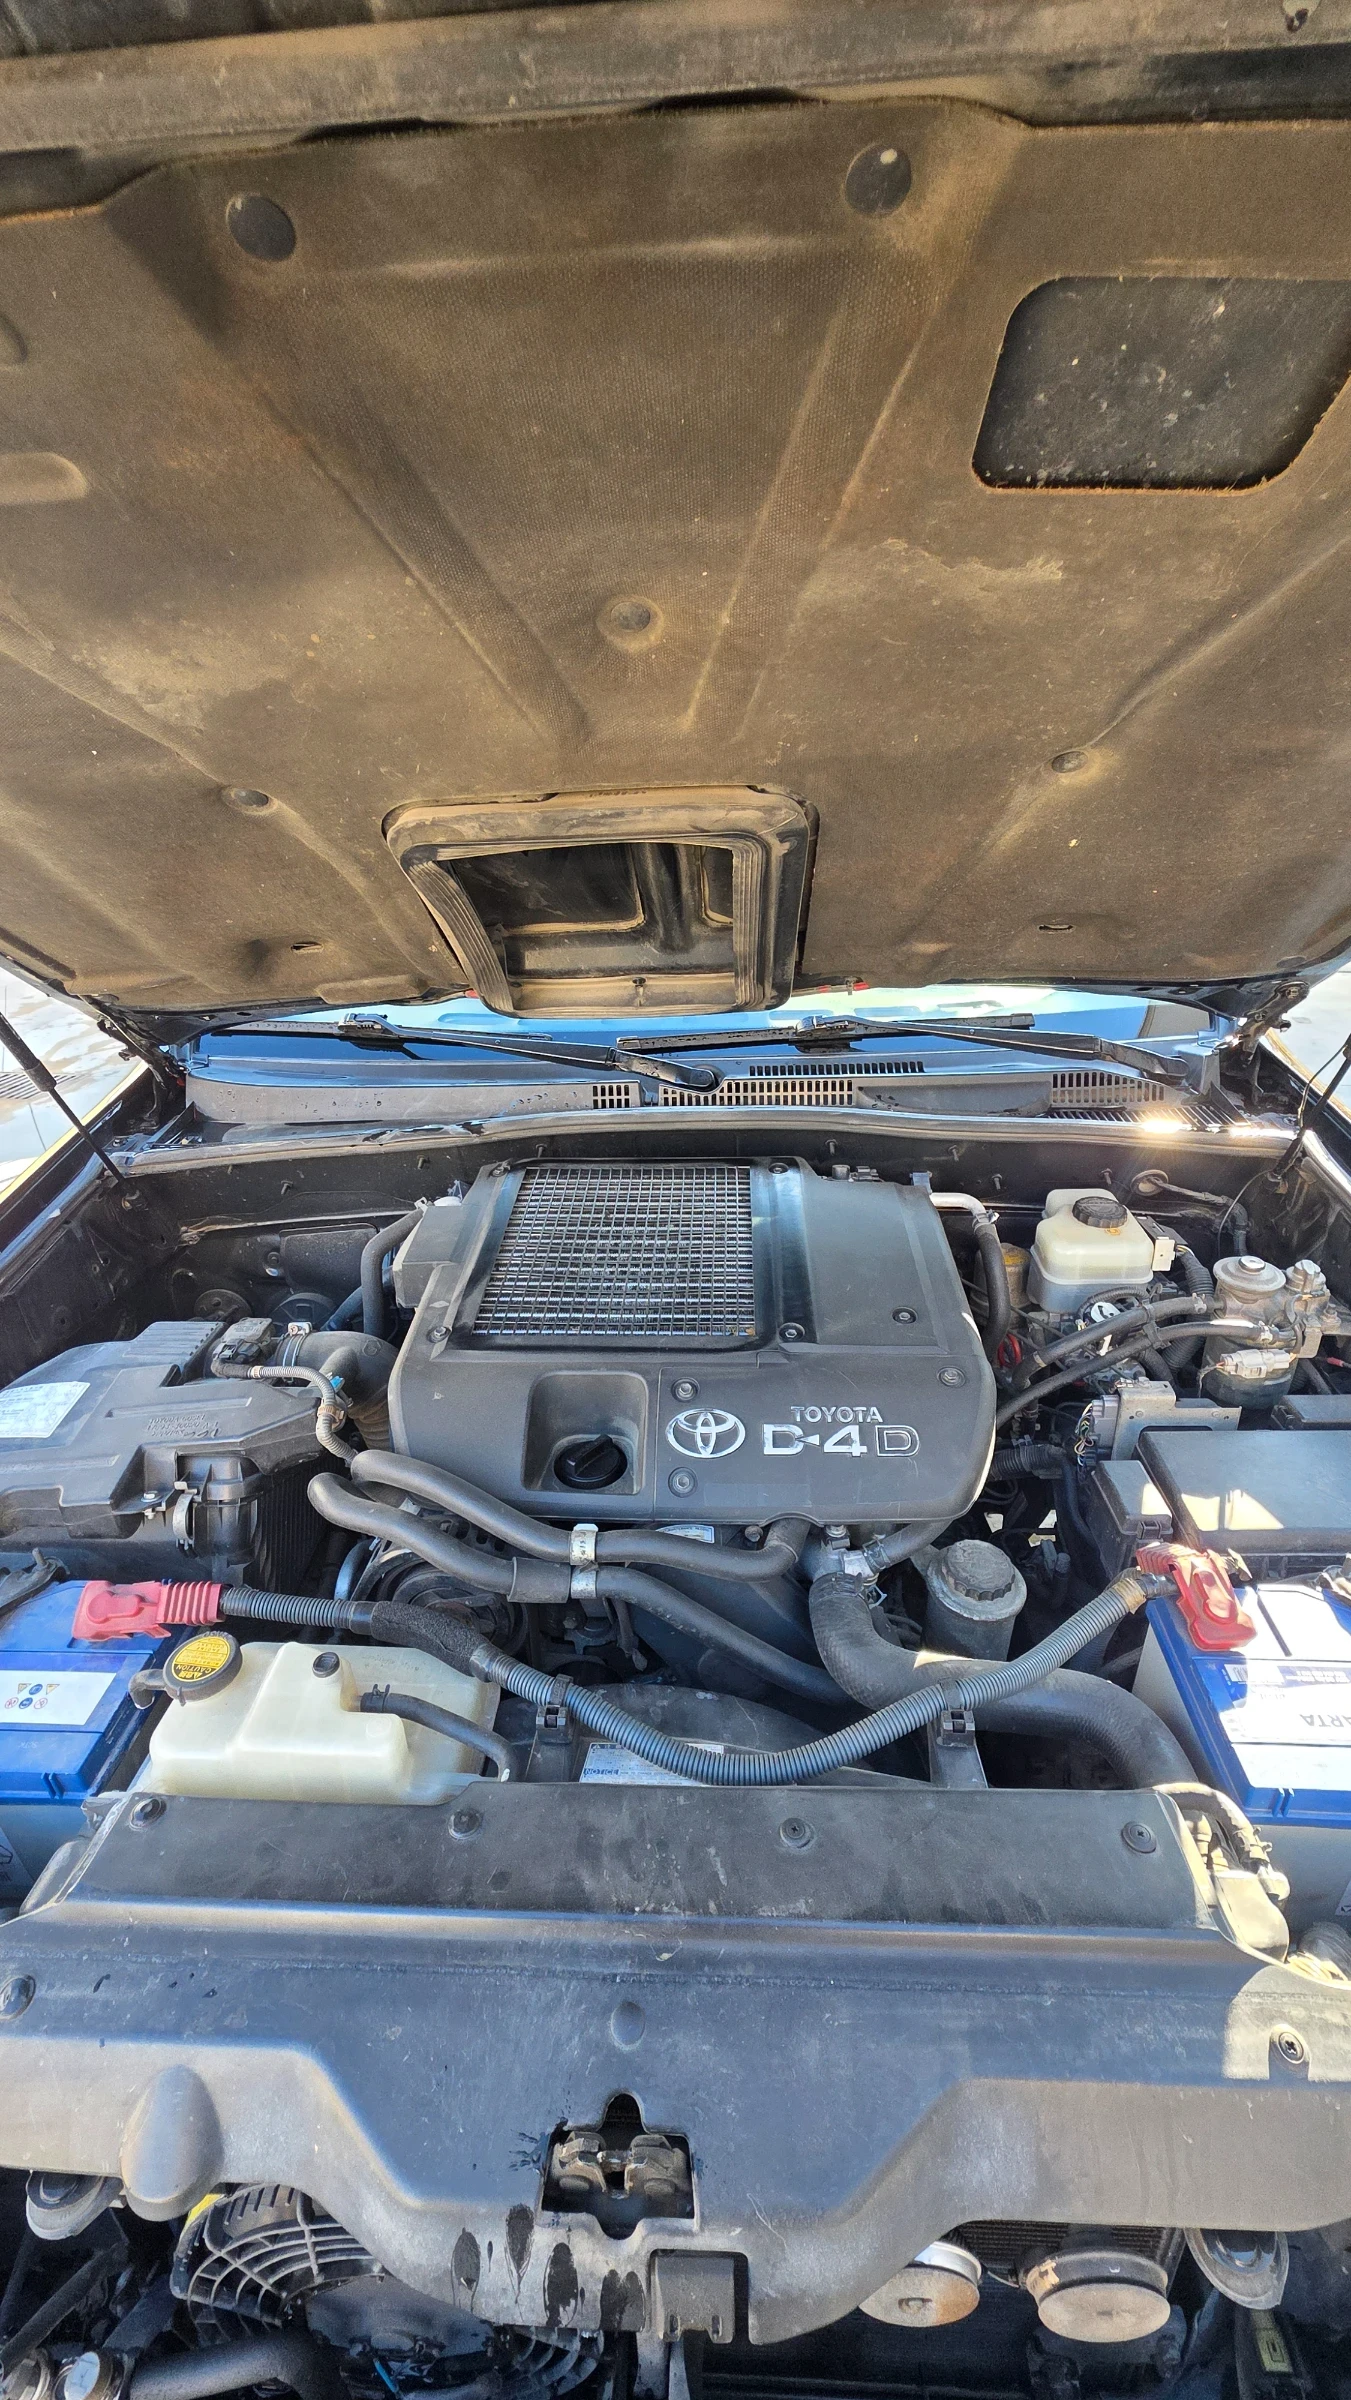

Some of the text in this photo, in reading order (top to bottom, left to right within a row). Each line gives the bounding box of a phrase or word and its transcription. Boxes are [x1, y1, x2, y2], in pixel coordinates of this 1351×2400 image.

[790, 1405, 884, 1423] TOYOTA
[762, 1423, 921, 1458] D-4D
[176, 1664, 212, 1673] CAUTION
